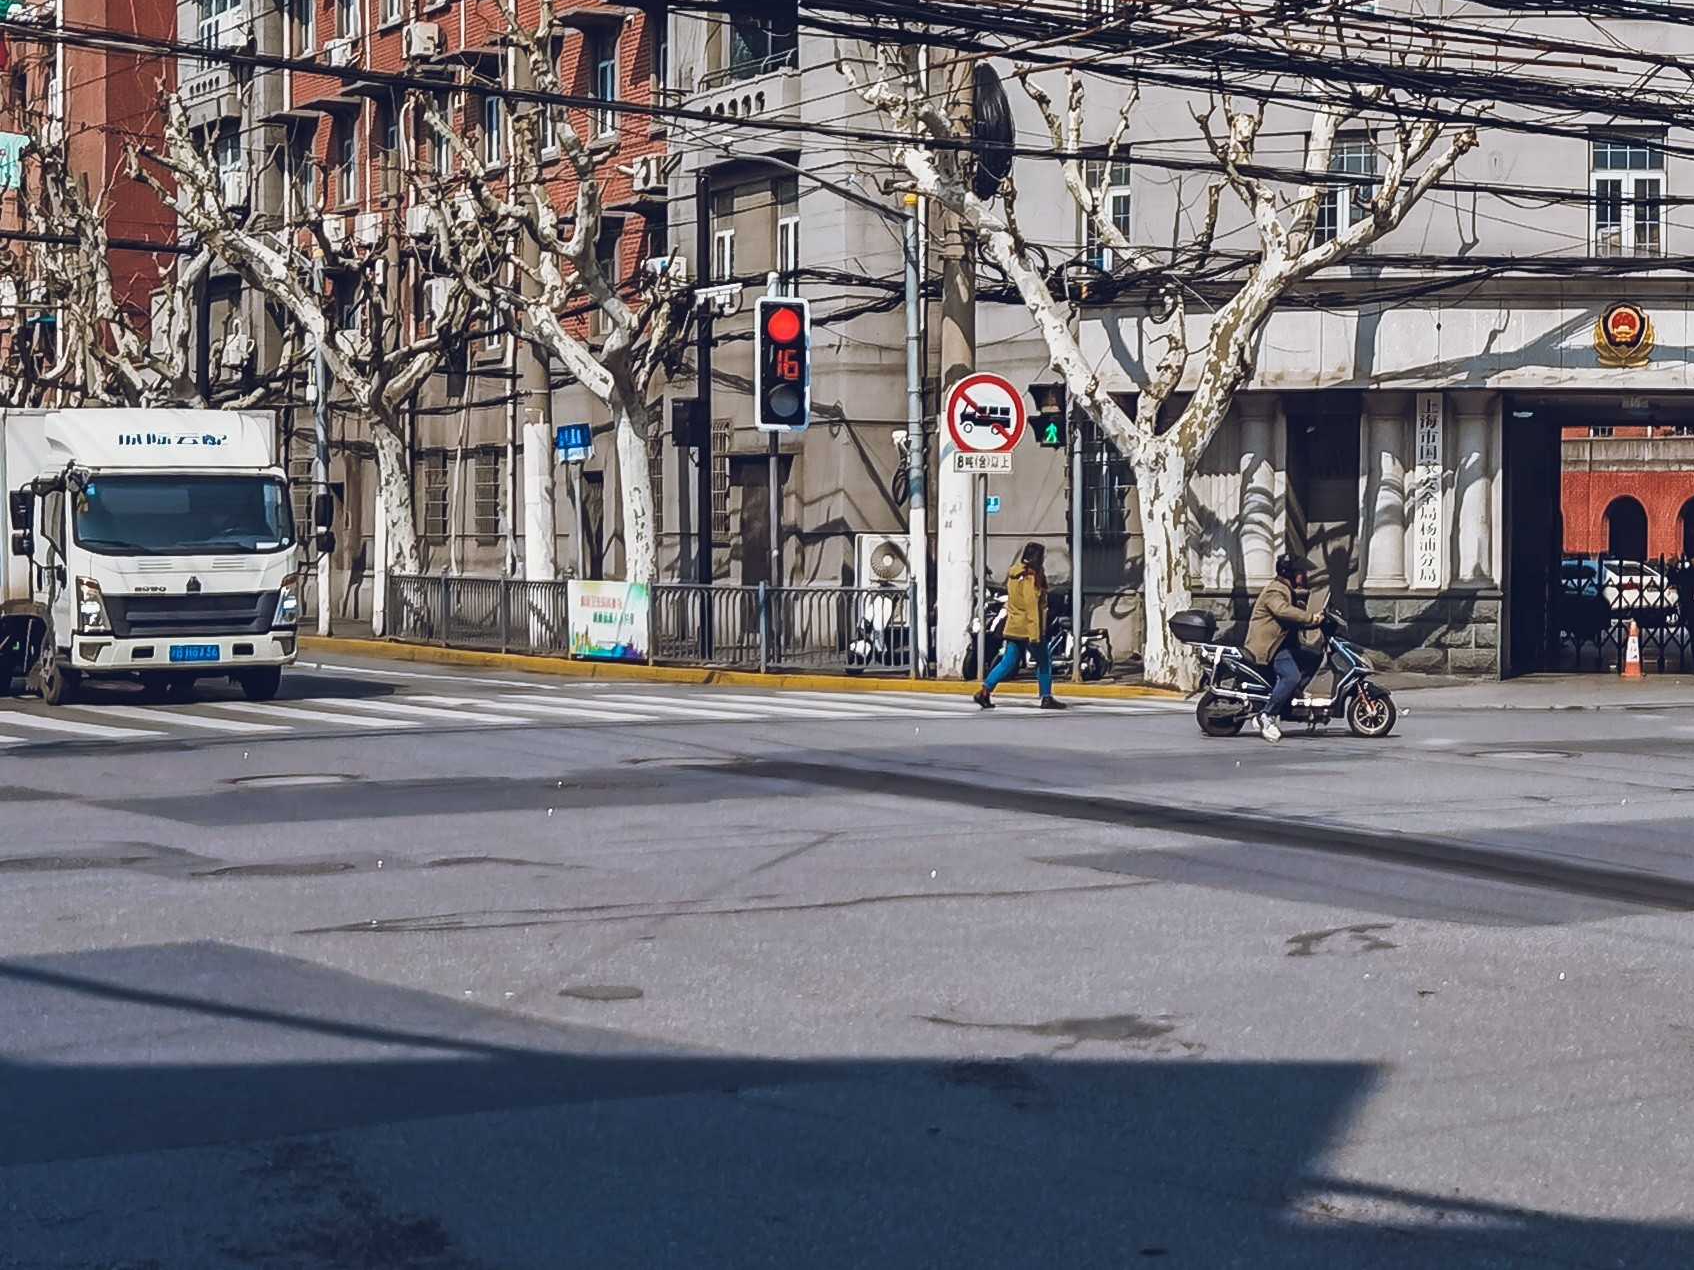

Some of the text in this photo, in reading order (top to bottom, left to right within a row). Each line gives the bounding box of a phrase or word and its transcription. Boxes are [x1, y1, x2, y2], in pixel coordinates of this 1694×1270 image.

[776, 349, 799, 380] 16
[1418, 397, 1440, 583] 上海市国家安全局杨浦分局
